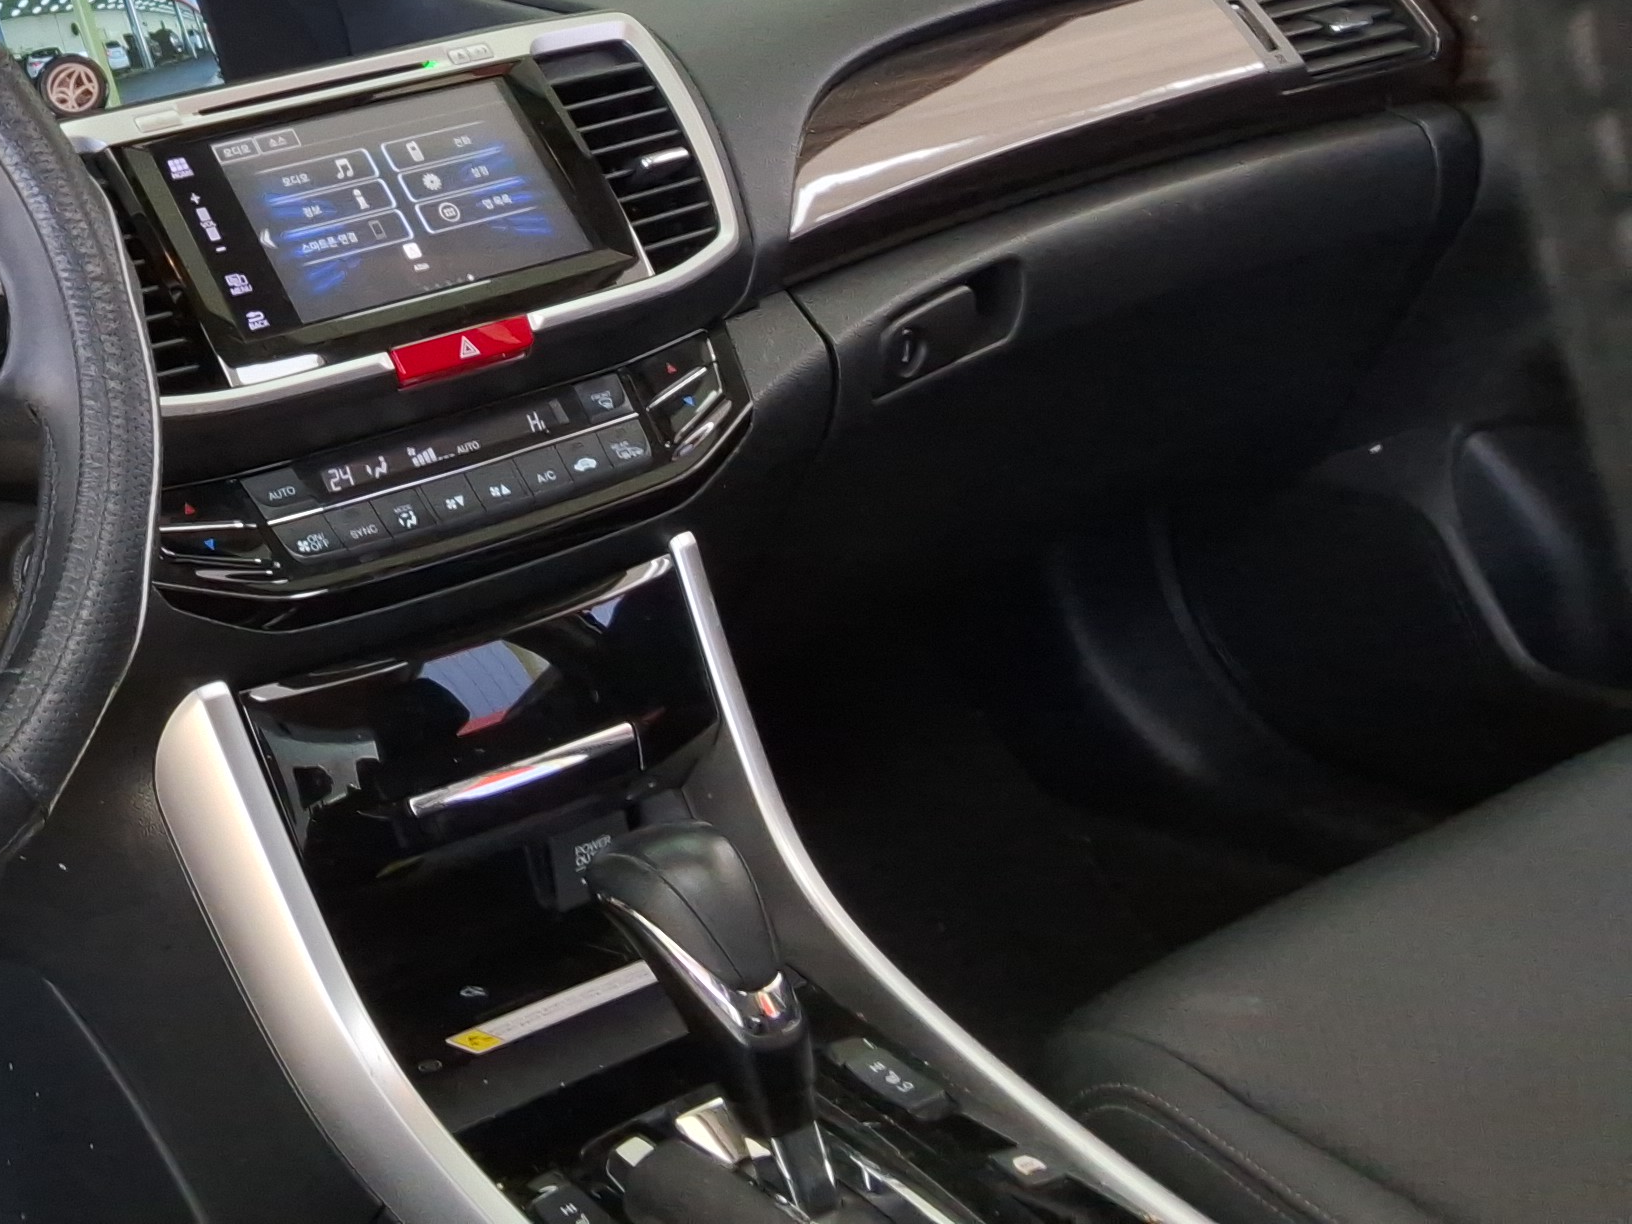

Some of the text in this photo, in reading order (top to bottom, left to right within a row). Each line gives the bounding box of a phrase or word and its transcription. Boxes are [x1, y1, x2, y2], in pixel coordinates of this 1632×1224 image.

[222, 144, 252, 158] 오디오
[282, 173, 310, 187] 오디오
[301, 236, 338, 253] 스마트폰
[456, 440, 481, 454] AUTO
[327, 465, 355, 492] 24
[536, 470, 557, 484] A/C
[268, 485, 296, 501] AUTO
[349, 525, 378, 539] SYNC
[311, 538, 330, 551] OFF
